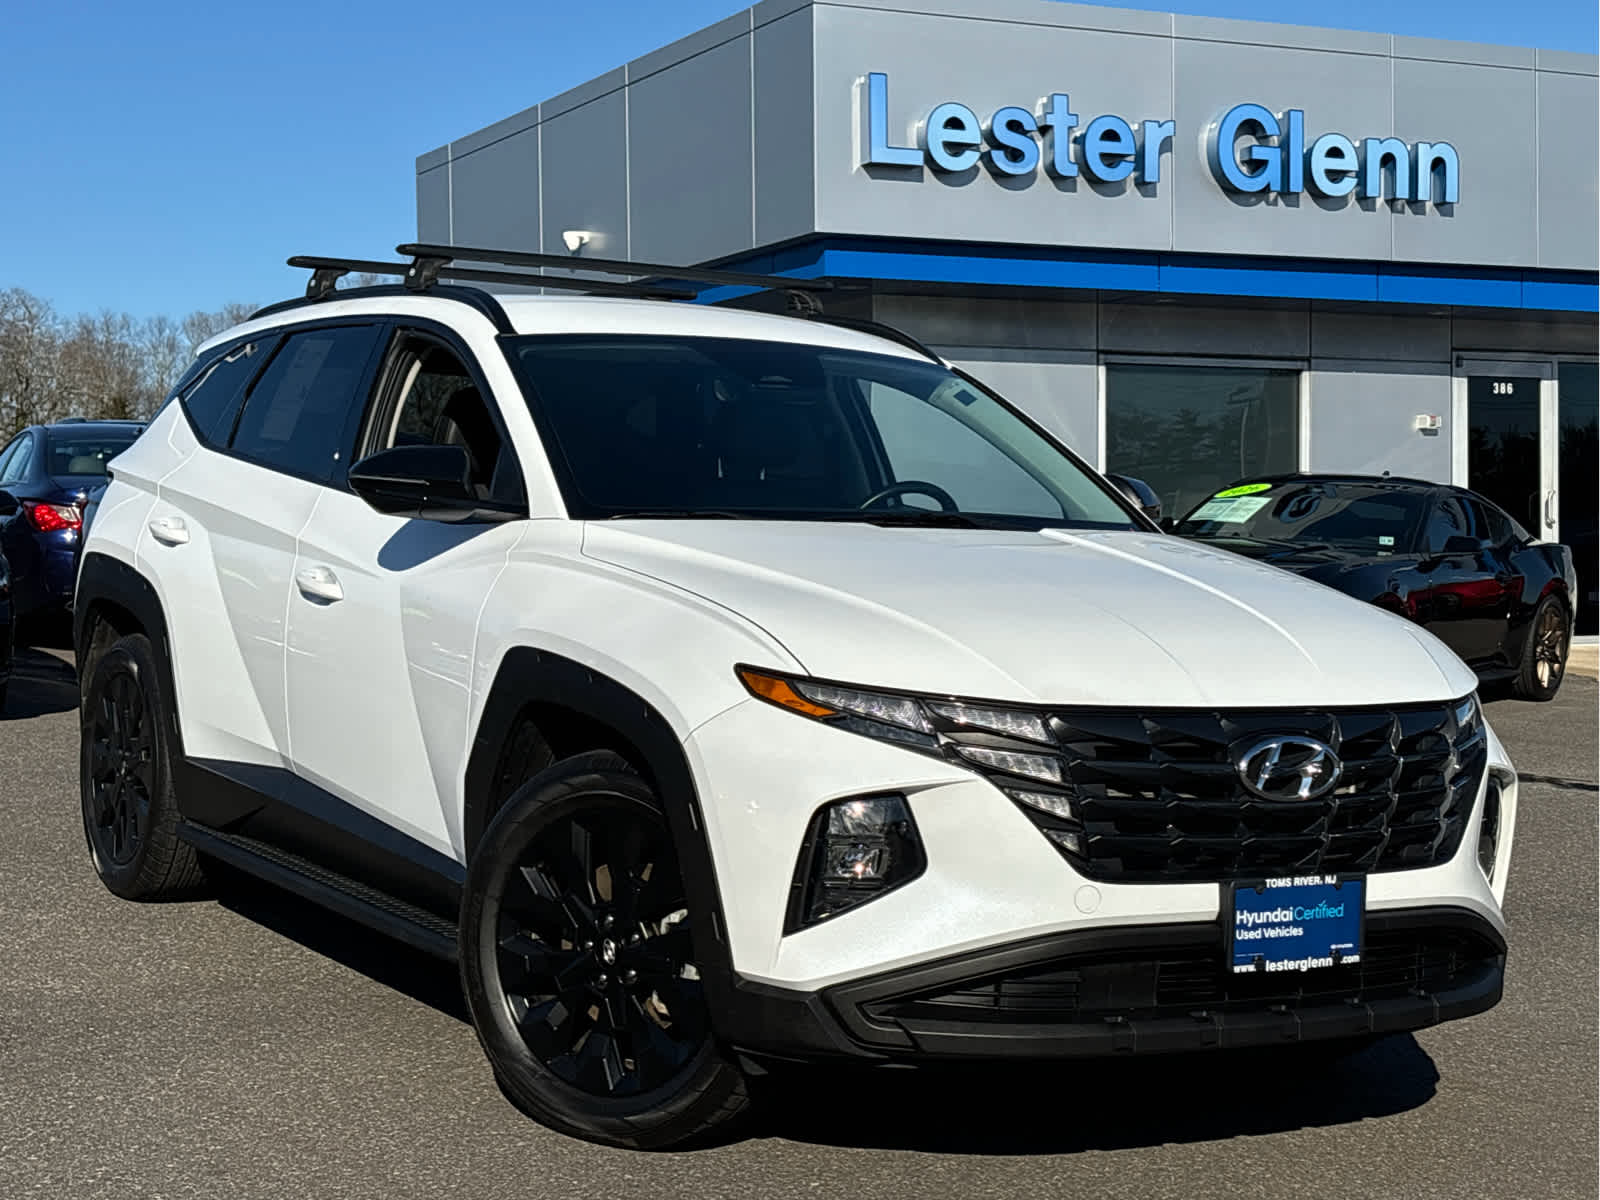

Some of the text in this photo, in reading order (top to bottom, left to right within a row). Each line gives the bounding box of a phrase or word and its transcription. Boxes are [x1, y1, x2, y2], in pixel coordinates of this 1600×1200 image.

[858, 72, 1460, 204] Lester Glenn
[1493, 382, 1514, 395] 386
[1265, 877, 1292, 889] TOMS
[1324, 873, 1337, 885] NJ
[1236, 925, 1304, 940] Used Vehicles
[1265, 956, 1333, 972] lesterglenn
